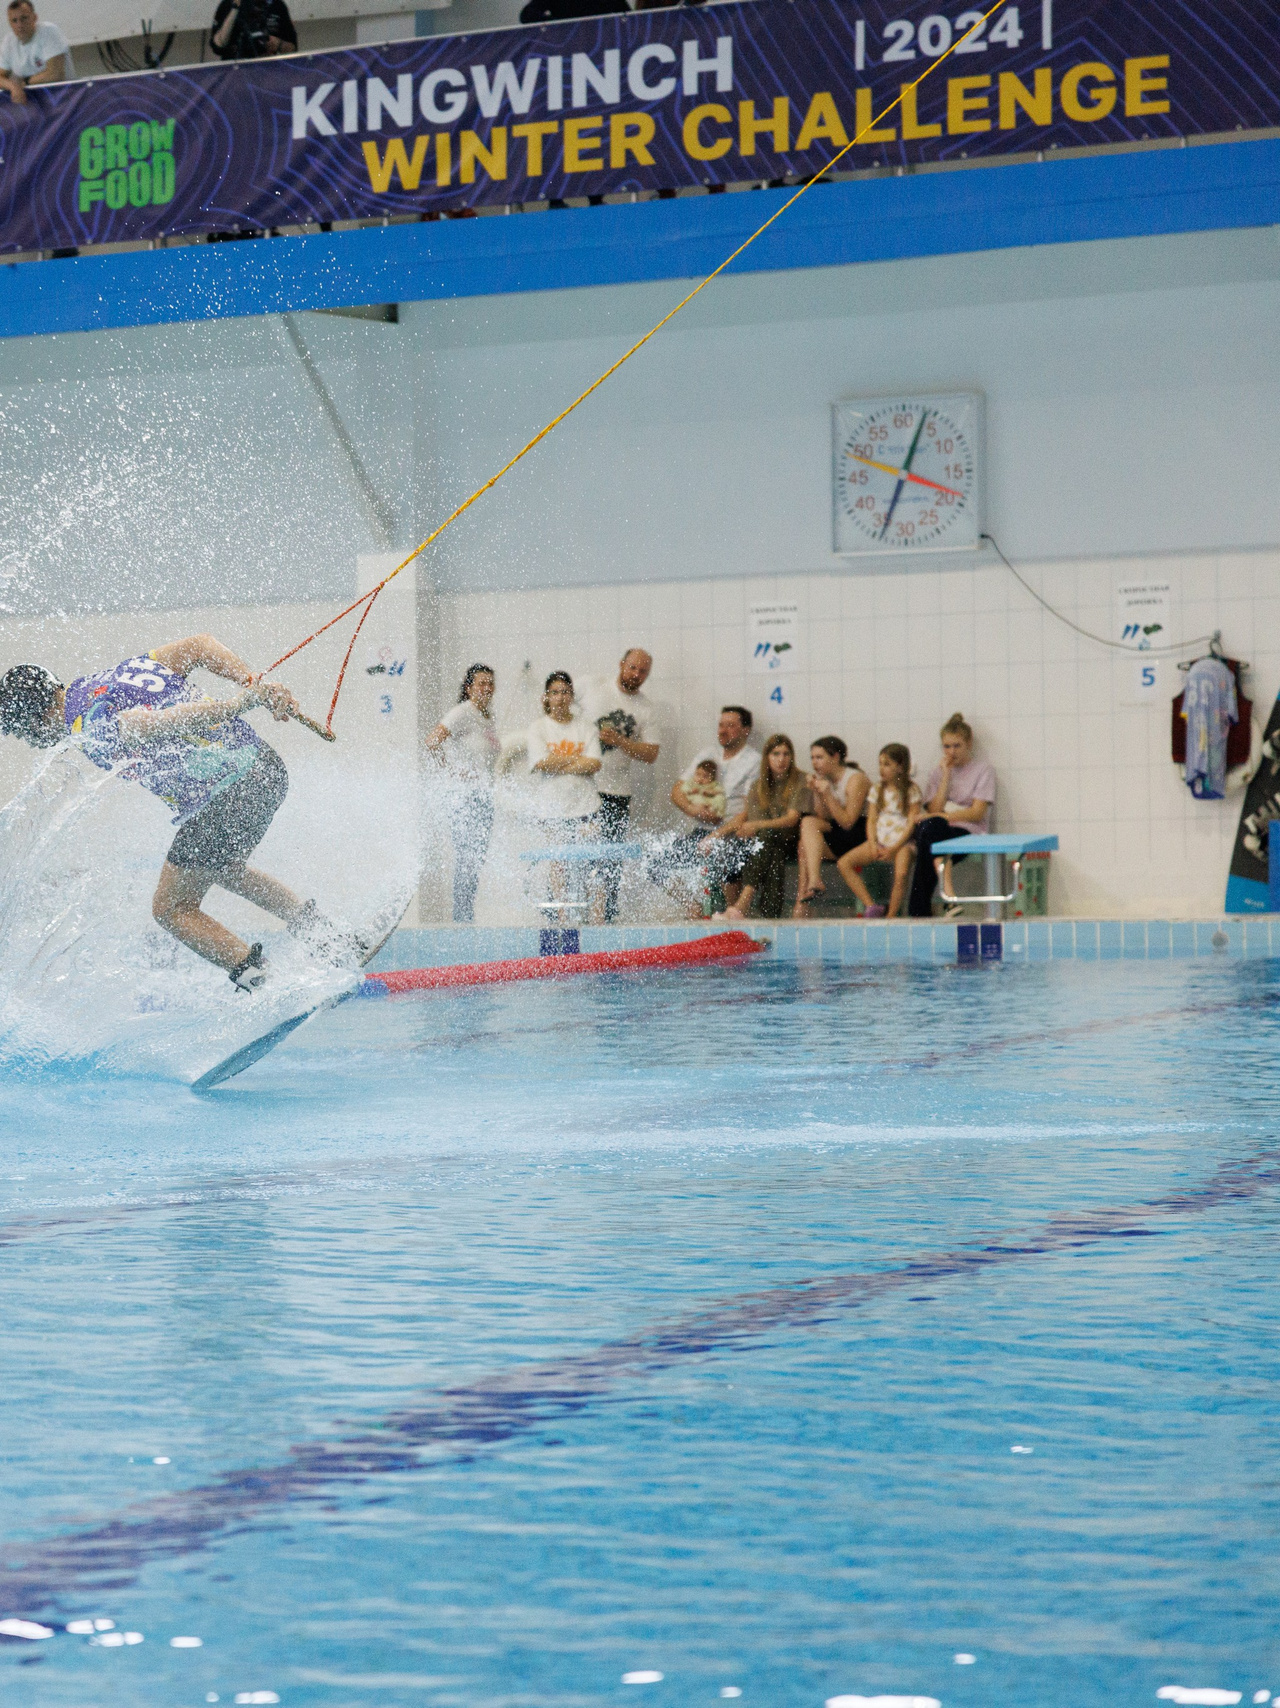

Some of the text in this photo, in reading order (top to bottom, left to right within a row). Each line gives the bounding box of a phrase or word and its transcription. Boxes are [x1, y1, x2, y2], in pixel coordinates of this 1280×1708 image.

[883, 7, 1024, 63] 2024
[292, 36, 734, 139] KINGWINCH
[361, 55, 1170, 193] WINTER CHALLENGE
[79, 118, 176, 179] GROW
[79, 151, 175, 212] FOOD
[893, 412, 914, 429] 60
[869, 425, 889, 441] 55
[926, 421, 937, 438] 5
[935, 438, 954, 454] 10
[848, 469, 869, 485] 45
[944, 463, 963, 480] 15
[855, 495, 875, 511] 40
[919, 509, 939, 526] 25
[896, 521, 915, 537] 30
[1142, 667, 1156, 687] 5
[770, 686, 784, 704] 4
[380, 694, 393, 714] 3
